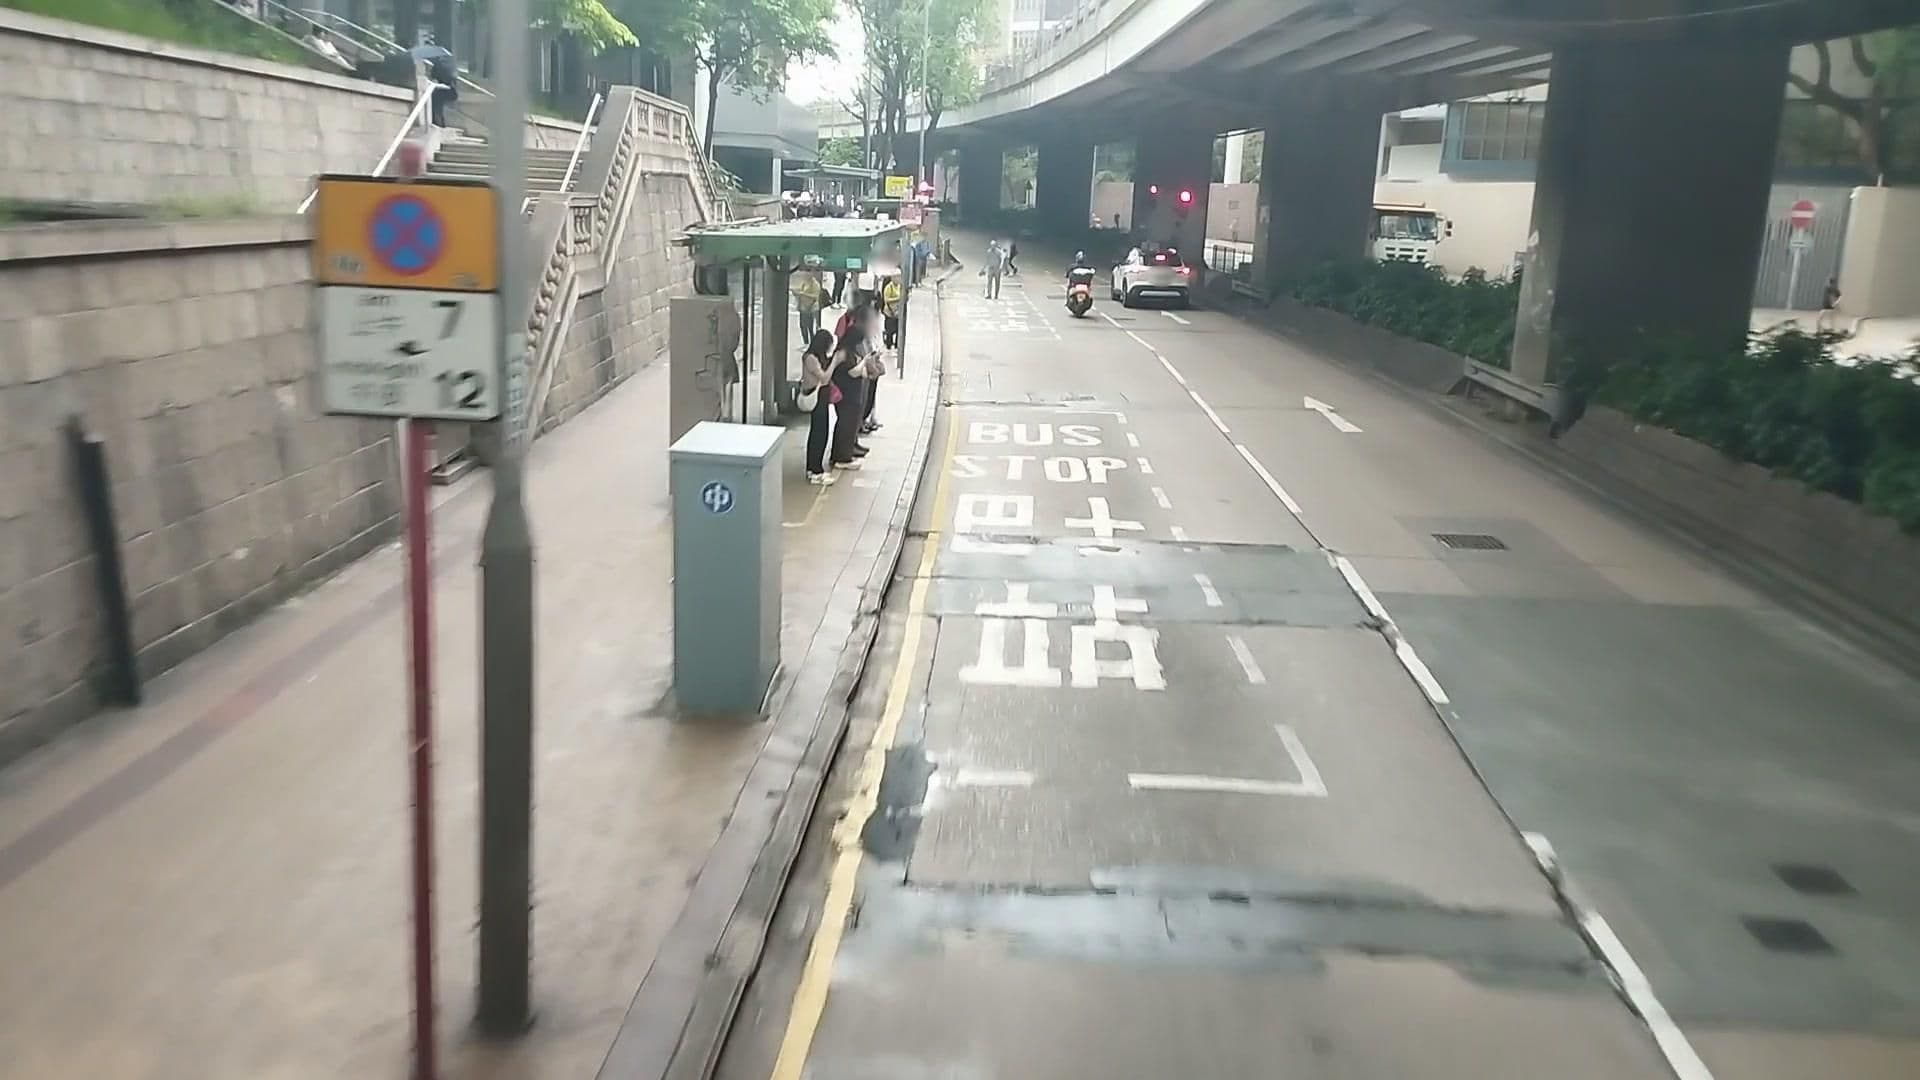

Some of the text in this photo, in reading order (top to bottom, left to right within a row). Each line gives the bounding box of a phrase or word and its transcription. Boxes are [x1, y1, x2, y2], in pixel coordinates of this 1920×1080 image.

[432, 299, 465, 340] 7
[433, 370, 487, 409] 12
[967, 422, 1101, 446] BUS
[949, 455, 1128, 483] STOP
